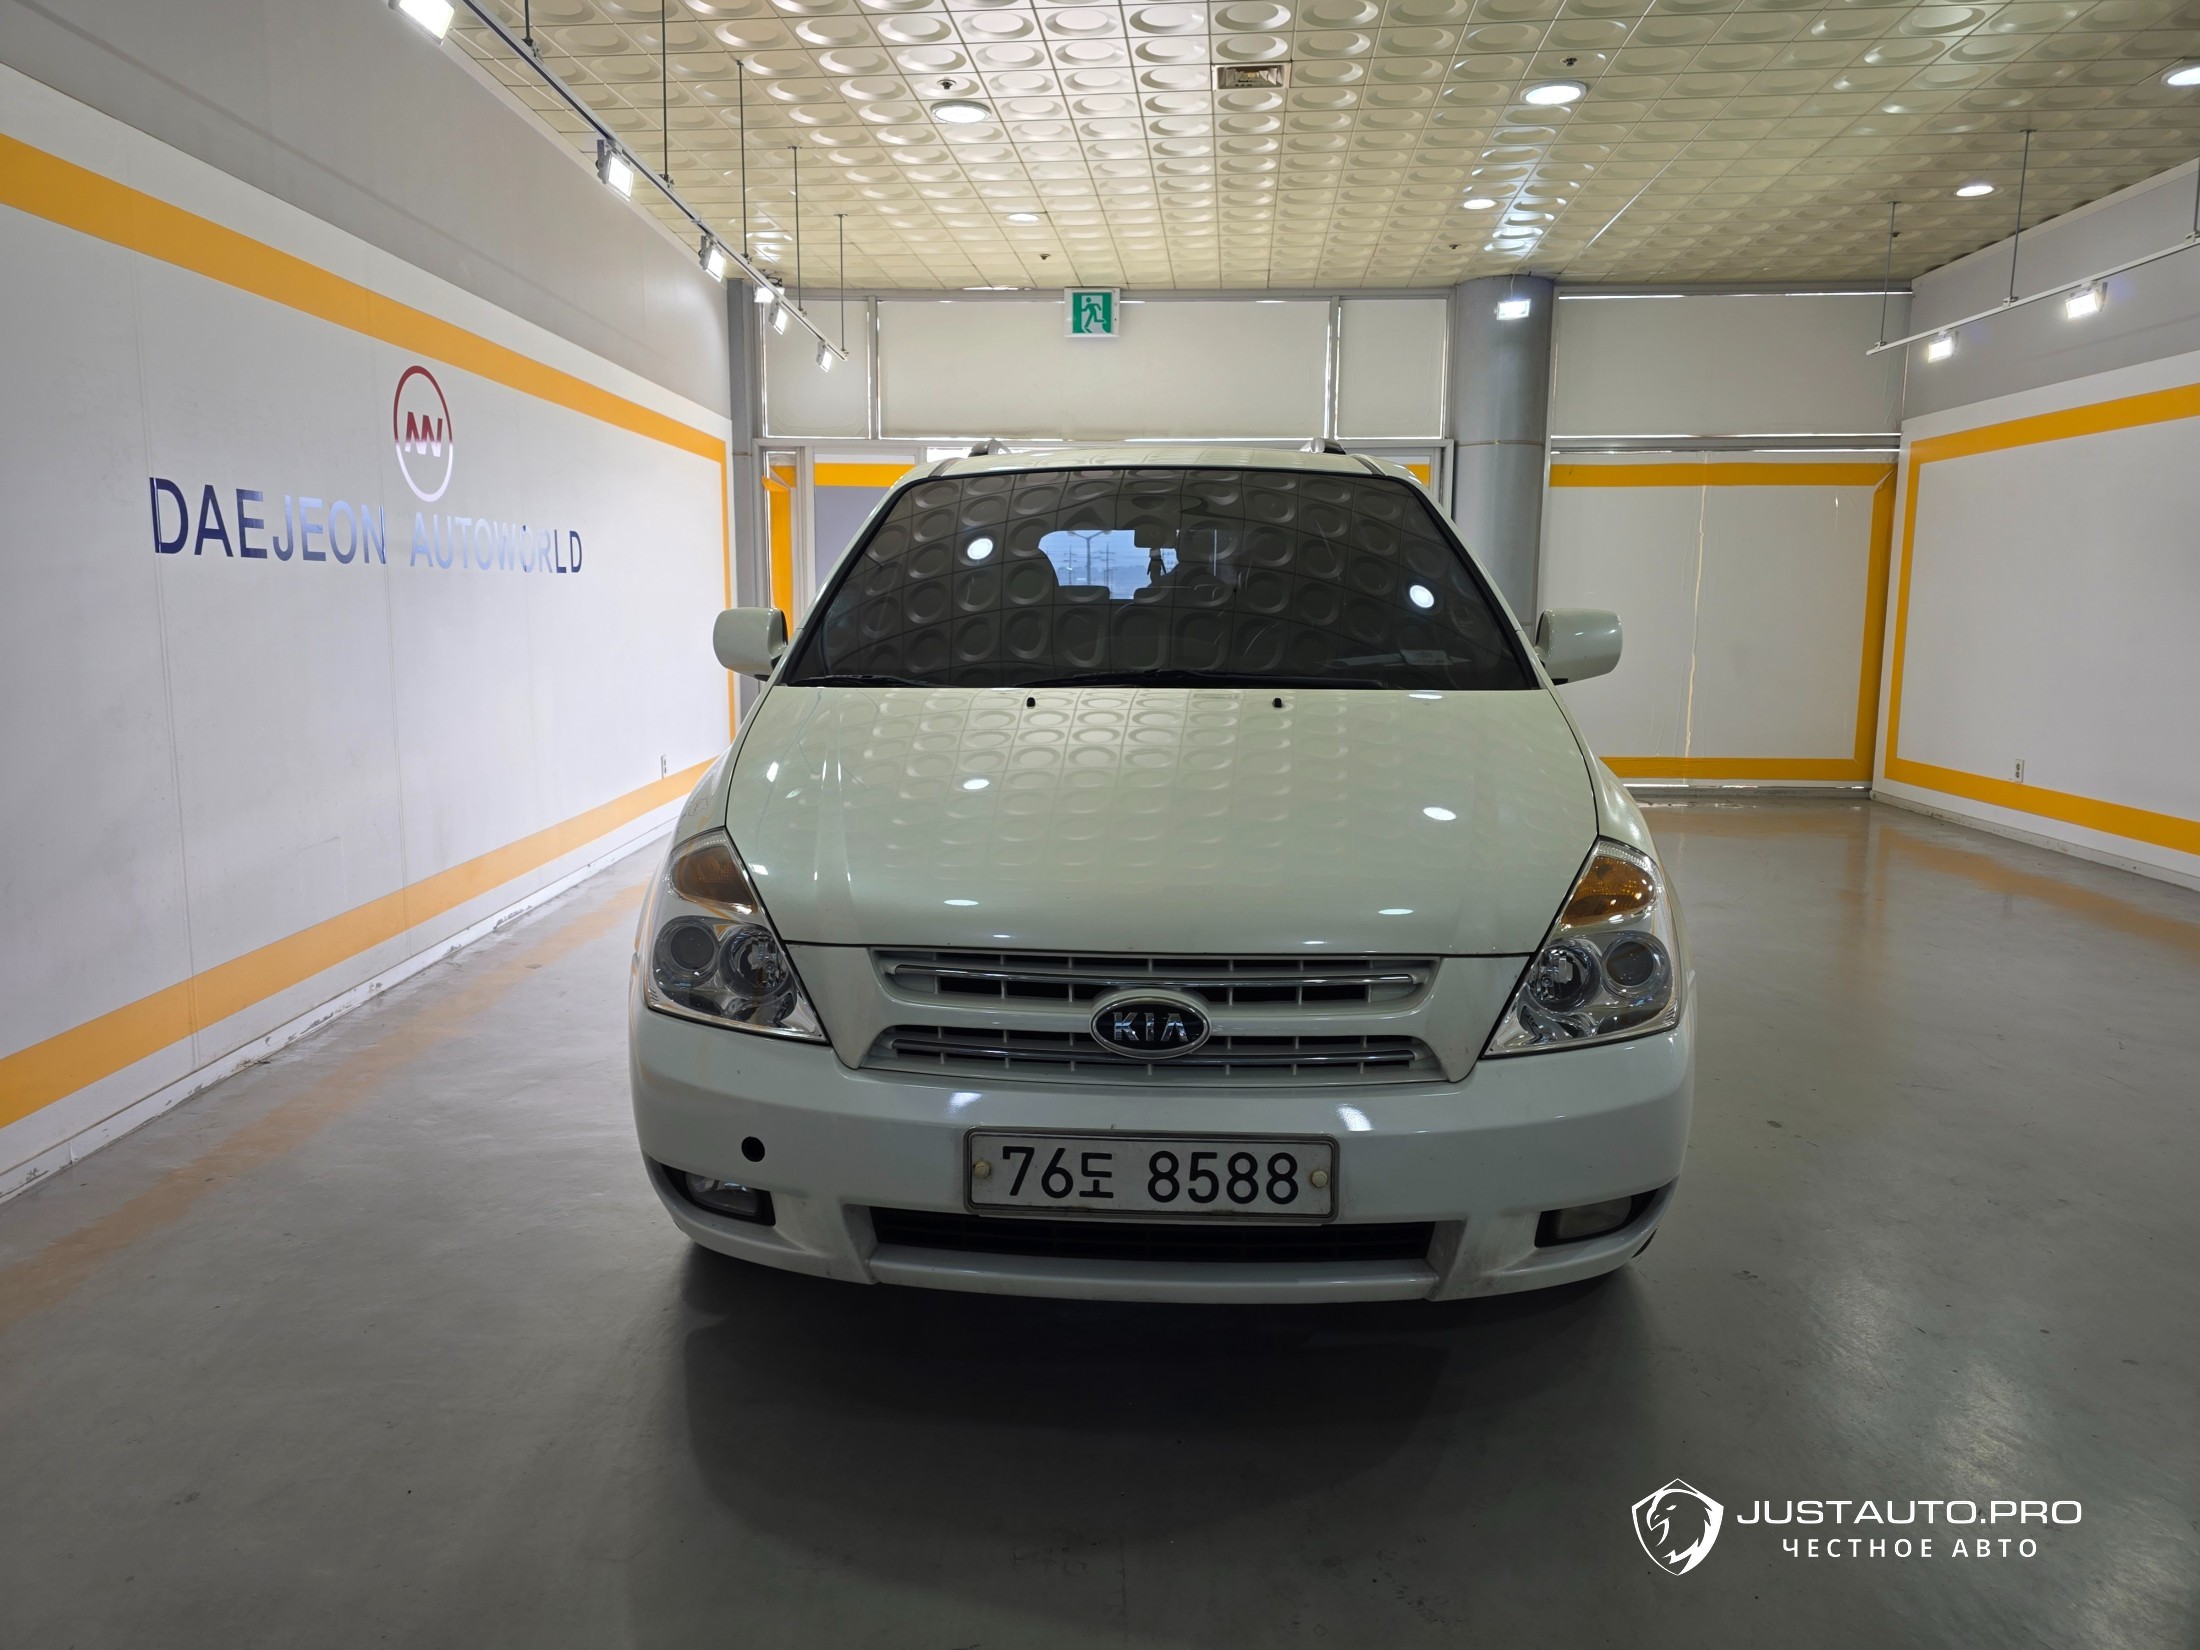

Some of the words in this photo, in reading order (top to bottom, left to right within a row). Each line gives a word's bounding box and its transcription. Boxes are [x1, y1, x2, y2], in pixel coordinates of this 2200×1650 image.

[149, 476, 387, 565] DAEJEON
[410, 511, 583, 574] AUTOWORLD
[1112, 1011, 1189, 1043] KIA
[1002, 1145, 1114, 1199] 76도
[1147, 1150, 1299, 1205] 8588
